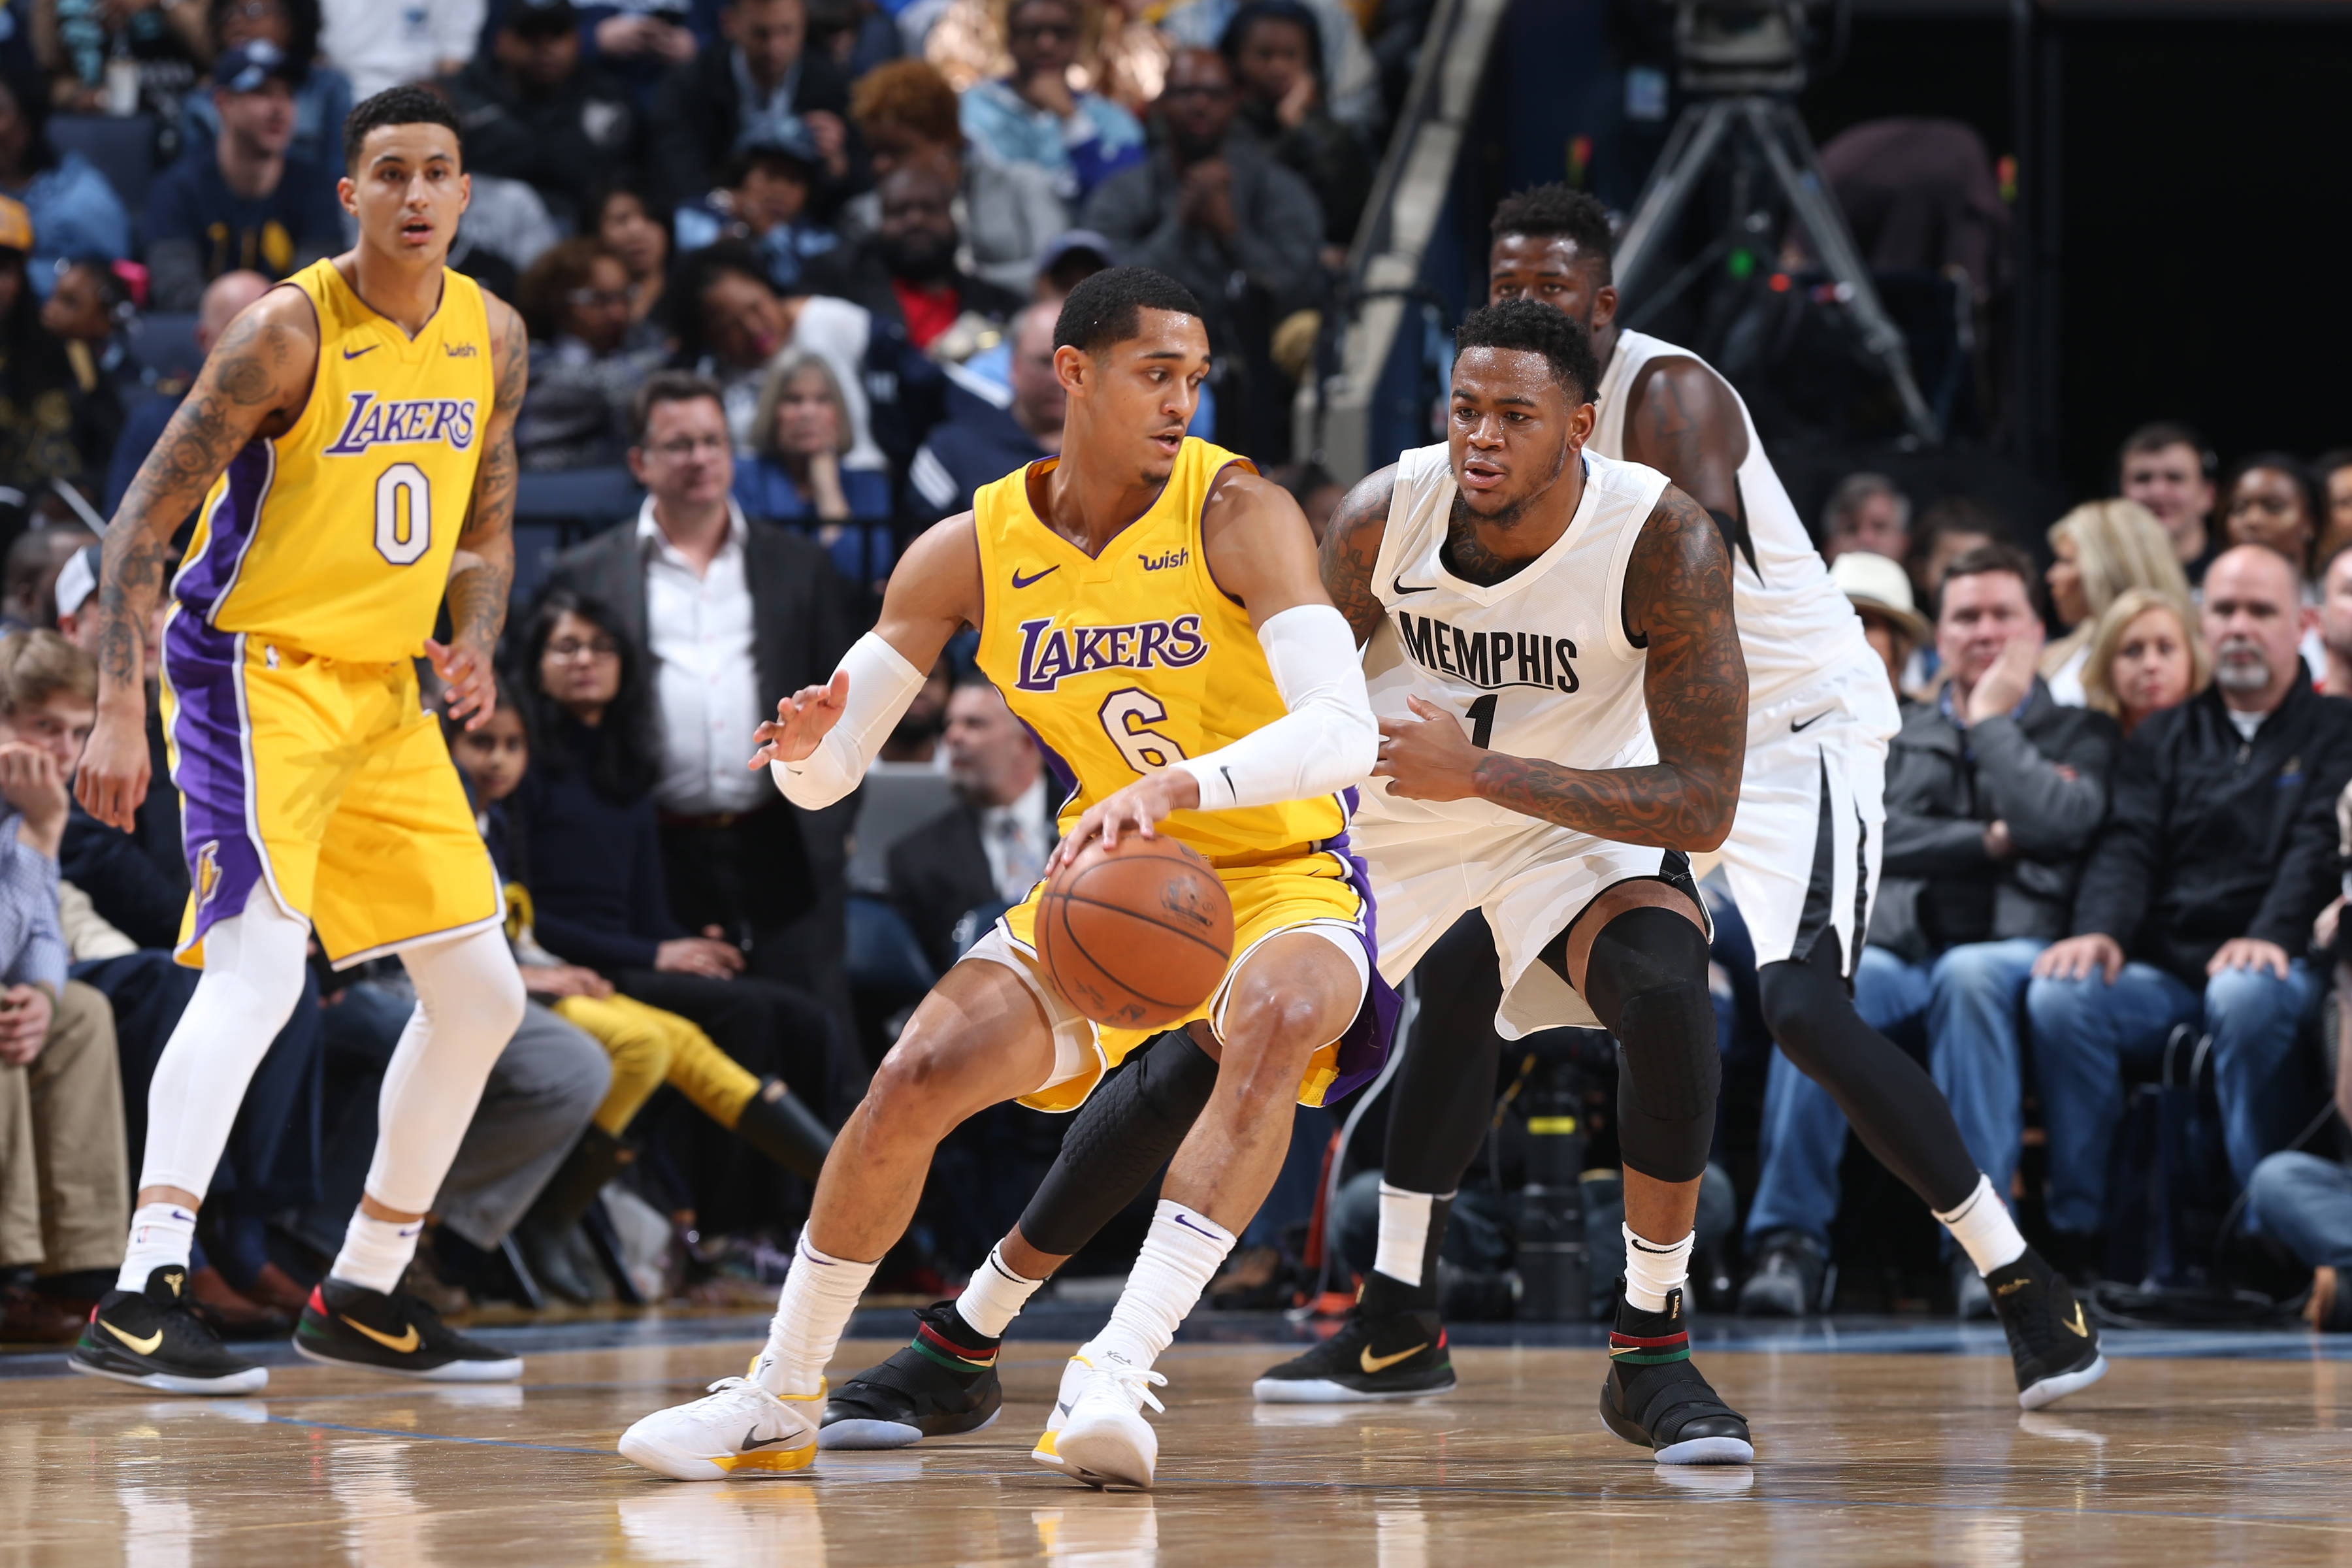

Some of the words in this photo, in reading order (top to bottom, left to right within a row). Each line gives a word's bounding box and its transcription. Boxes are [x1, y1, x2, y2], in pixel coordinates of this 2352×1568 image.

[444, 342, 476, 357] wish
[322, 391, 476, 455] LAKERS
[374, 463, 431, 565] 0
[1138, 547, 1188, 571] wish
[1013, 614, 1210, 693] LAKERS
[1399, 610, 1579, 694] MEMPHIS
[1098, 687, 1188, 777] 6
[1465, 694, 1498, 749] 1
